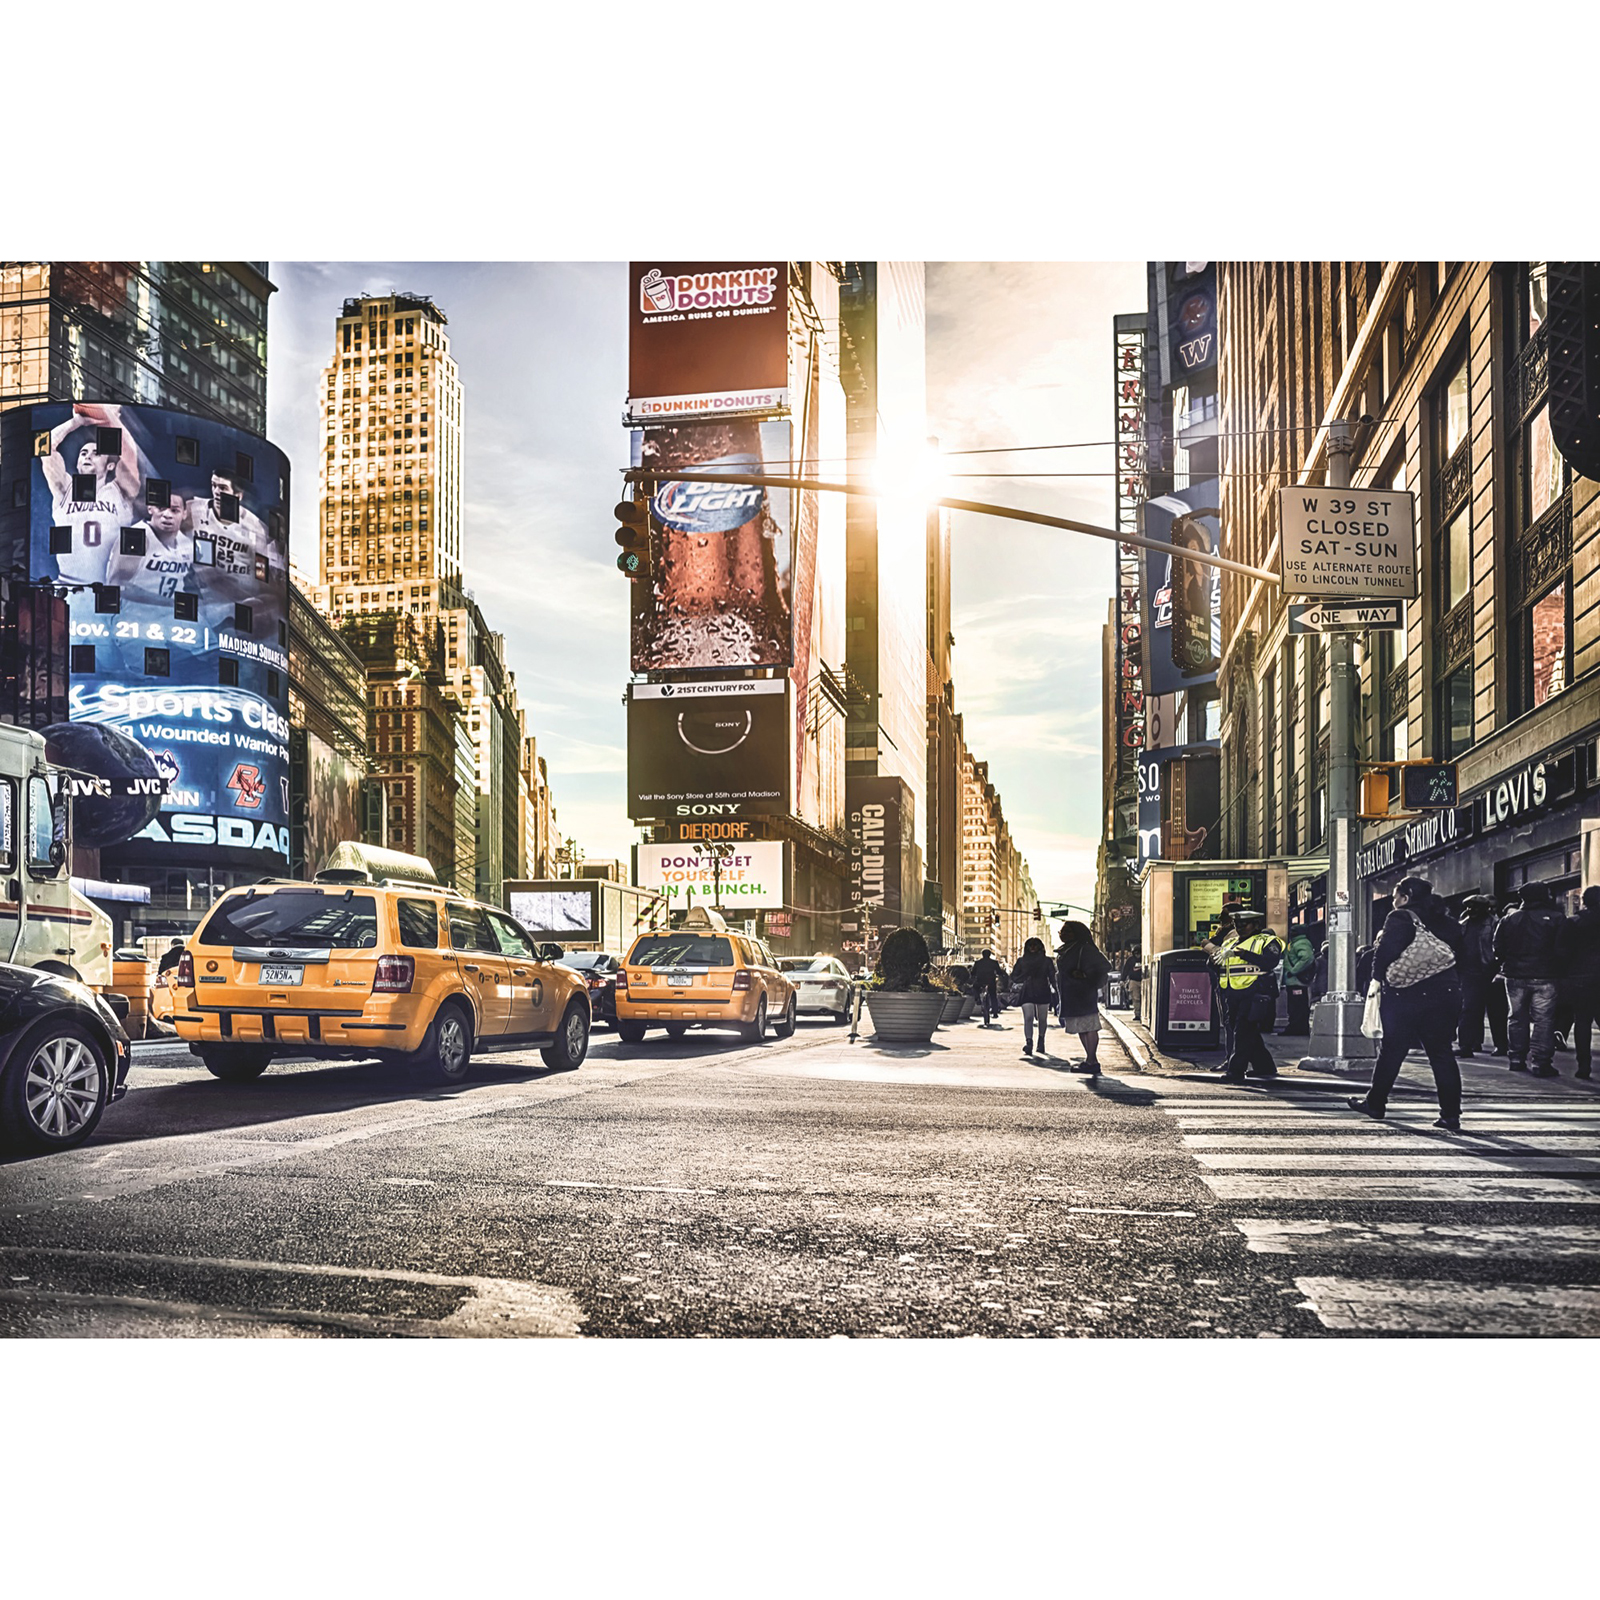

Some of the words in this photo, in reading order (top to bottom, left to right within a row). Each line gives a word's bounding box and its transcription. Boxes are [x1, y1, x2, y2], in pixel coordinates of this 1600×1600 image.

[678, 269, 776, 292] DUNKIN'
[678, 286, 770, 308] DONUTS
[642, 314, 686, 324] AMERICA
[688, 311, 713, 320] RUNS
[1180, 334, 1211, 367] W
[66, 500, 118, 516] INDIANA
[670, 490, 762, 512] LIGHT
[1302, 498, 1318, 513] W
[1329, 499, 1356, 514] 39
[1367, 501, 1392, 516] ST
[83, 521, 101, 547] 0
[1306, 519, 1389, 537] CLOSED
[217, 548, 234, 563] 25
[1300, 539, 1397, 558] SAT-SUN
[1286, 561, 1307, 571] USE
[1313, 562, 1373, 573] ALTERNATE
[1378, 564, 1411, 575] ROUTE
[1294, 574, 1307, 583] TO
[1313, 574, 1358, 585] LINCOLN
[1364, 576, 1405, 587] TUNNEL
[1185, 619, 1198, 629] THE
[1191, 614, 1205, 625] SEE
[1310, 611, 1341, 624] ONE
[1357, 608, 1390, 622] WAY
[115, 621, 139, 638] 21
[146, 623, 164, 640] &
[171, 626, 196, 644] 22
[1191, 629, 1209, 640] SHOW
[218, 633, 258, 656] MADISON
[259, 643, 280, 665] SQUARE
[697, 684, 737, 692] CENTURY
[99, 684, 233, 723] Sports
[140, 723, 230, 746] Wounded
[234, 734, 279, 757] Warrior
[62, 779, 112, 796] JVC
[127, 779, 161, 795] JVC
[639, 793, 653, 801] Visit
[654, 792, 665, 800] the
[667, 792, 685, 801] Sony
[715, 791, 730, 799] 55th
[748, 790, 780, 798] Madison
[676, 803, 741, 816] SONY
[862, 804, 884, 849] CALL
[127, 814, 290, 864] ASDAQ
[1376, 837, 1396, 871] GUMP
[1405, 816, 1438, 858] SHRIMP
[661, 856, 713, 868] DON'T
[721, 855, 752, 867] GET
[852, 812, 861, 901] GHOSTS
[862, 855, 884, 906] DUTY
[661, 885, 679, 896] IN
[685, 884, 696, 896] A
[702, 884, 767, 895] BUNCH.
